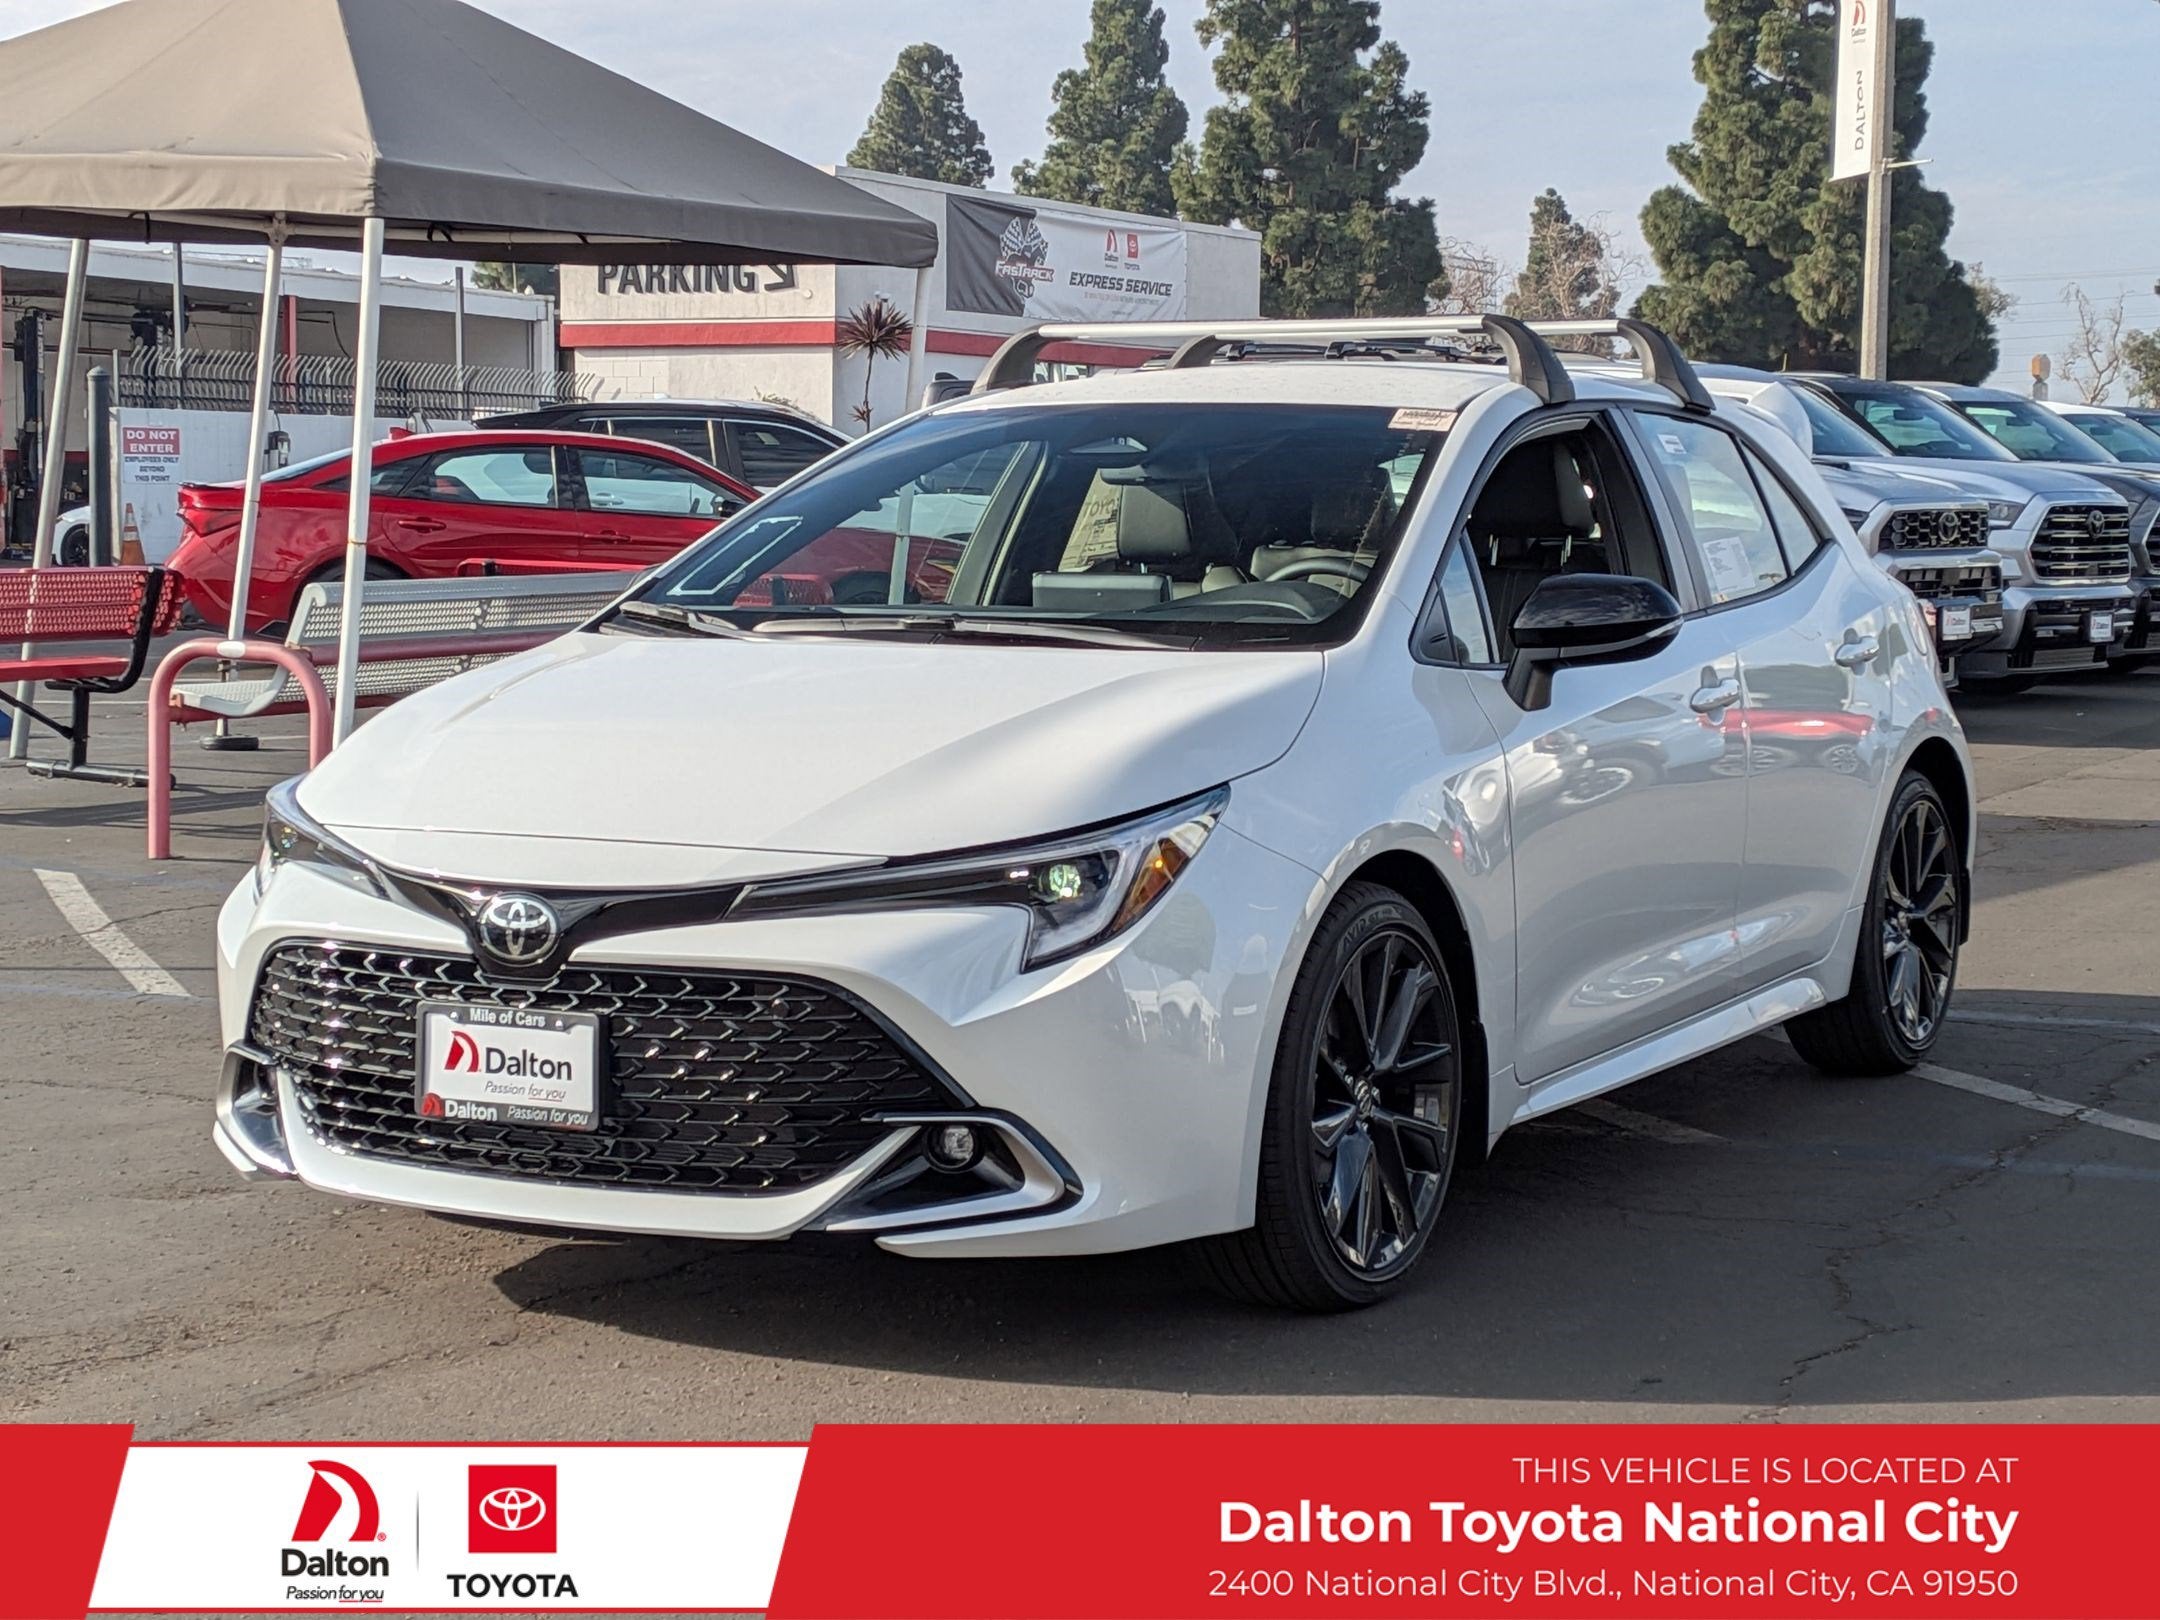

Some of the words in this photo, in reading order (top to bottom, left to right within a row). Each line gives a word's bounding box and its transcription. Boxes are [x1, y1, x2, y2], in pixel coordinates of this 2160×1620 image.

[1854, 70, 1865, 151] DALTON
[598, 264, 757, 294] PARKING
[1069, 271, 1125, 291] EXPRESS
[1125, 278, 1173, 297] SERVICE
[126, 430, 146, 440] DO
[149, 430, 177, 440] NOT
[129, 443, 174, 453] ENTER
[470, 1008, 497, 1024] Mile
[499, 1011, 515, 1025] of
[516, 1013, 546, 1028] Cars
[485, 1047, 573, 1081] Dalton
[484, 1080, 526, 1096] Passion
[527, 1083, 544, 1097] for
[545, 1088, 567, 1101] you
[445, 1101, 498, 1121] Dalton
[507, 1104, 548, 1121] Passion
[550, 1108, 566, 1122] for
[567, 1111, 589, 1126] you
